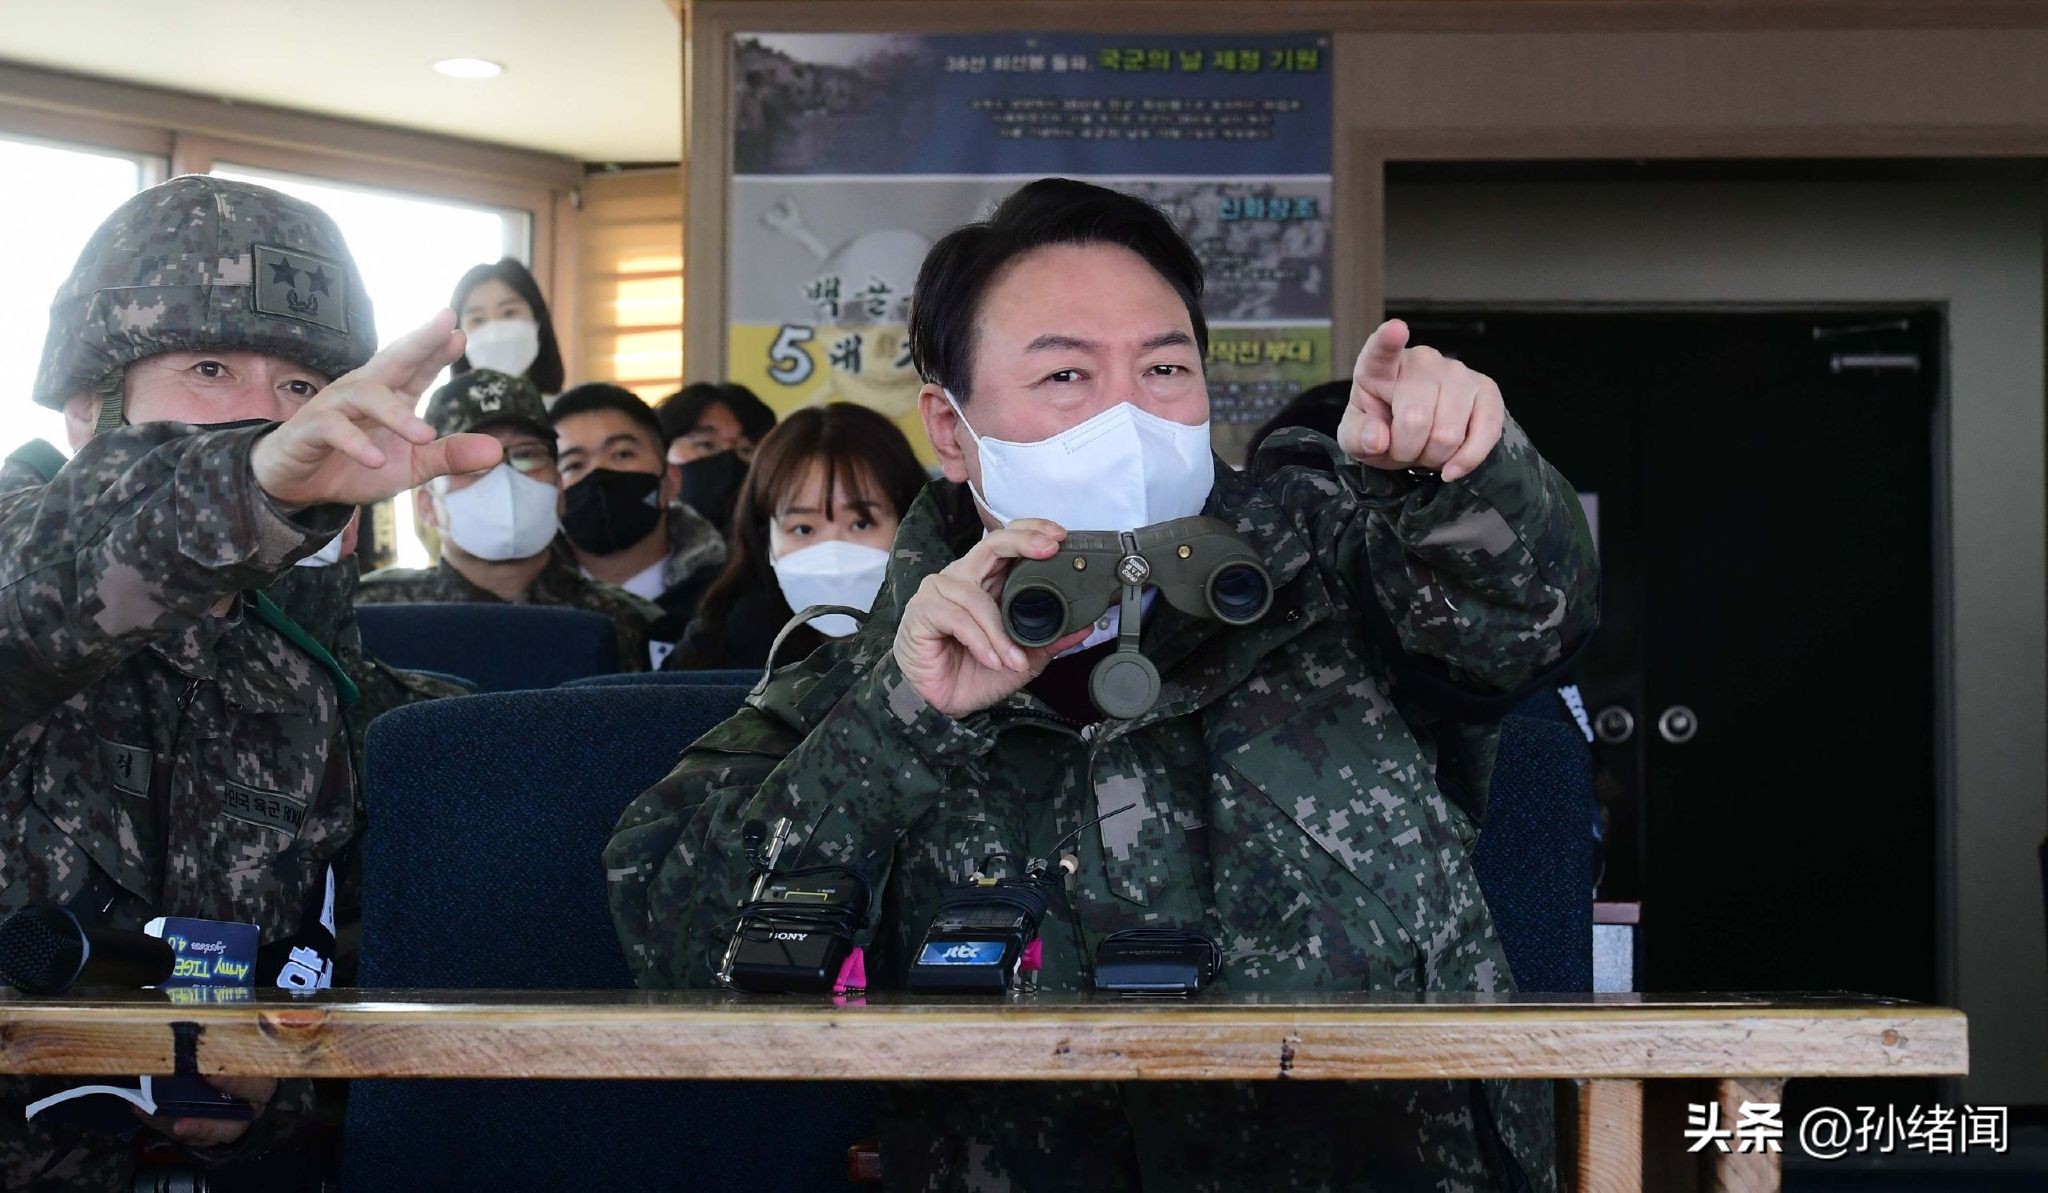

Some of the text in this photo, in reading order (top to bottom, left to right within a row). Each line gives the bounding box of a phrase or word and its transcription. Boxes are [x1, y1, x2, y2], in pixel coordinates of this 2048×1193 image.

[1099, 48, 1170, 72] 국군의
[1268, 48, 1318, 72] 기원
[1207, 340, 1261, 364] 작전
[223, 786, 251, 812] 민국
[173, 957, 249, 980] Army TIGE
